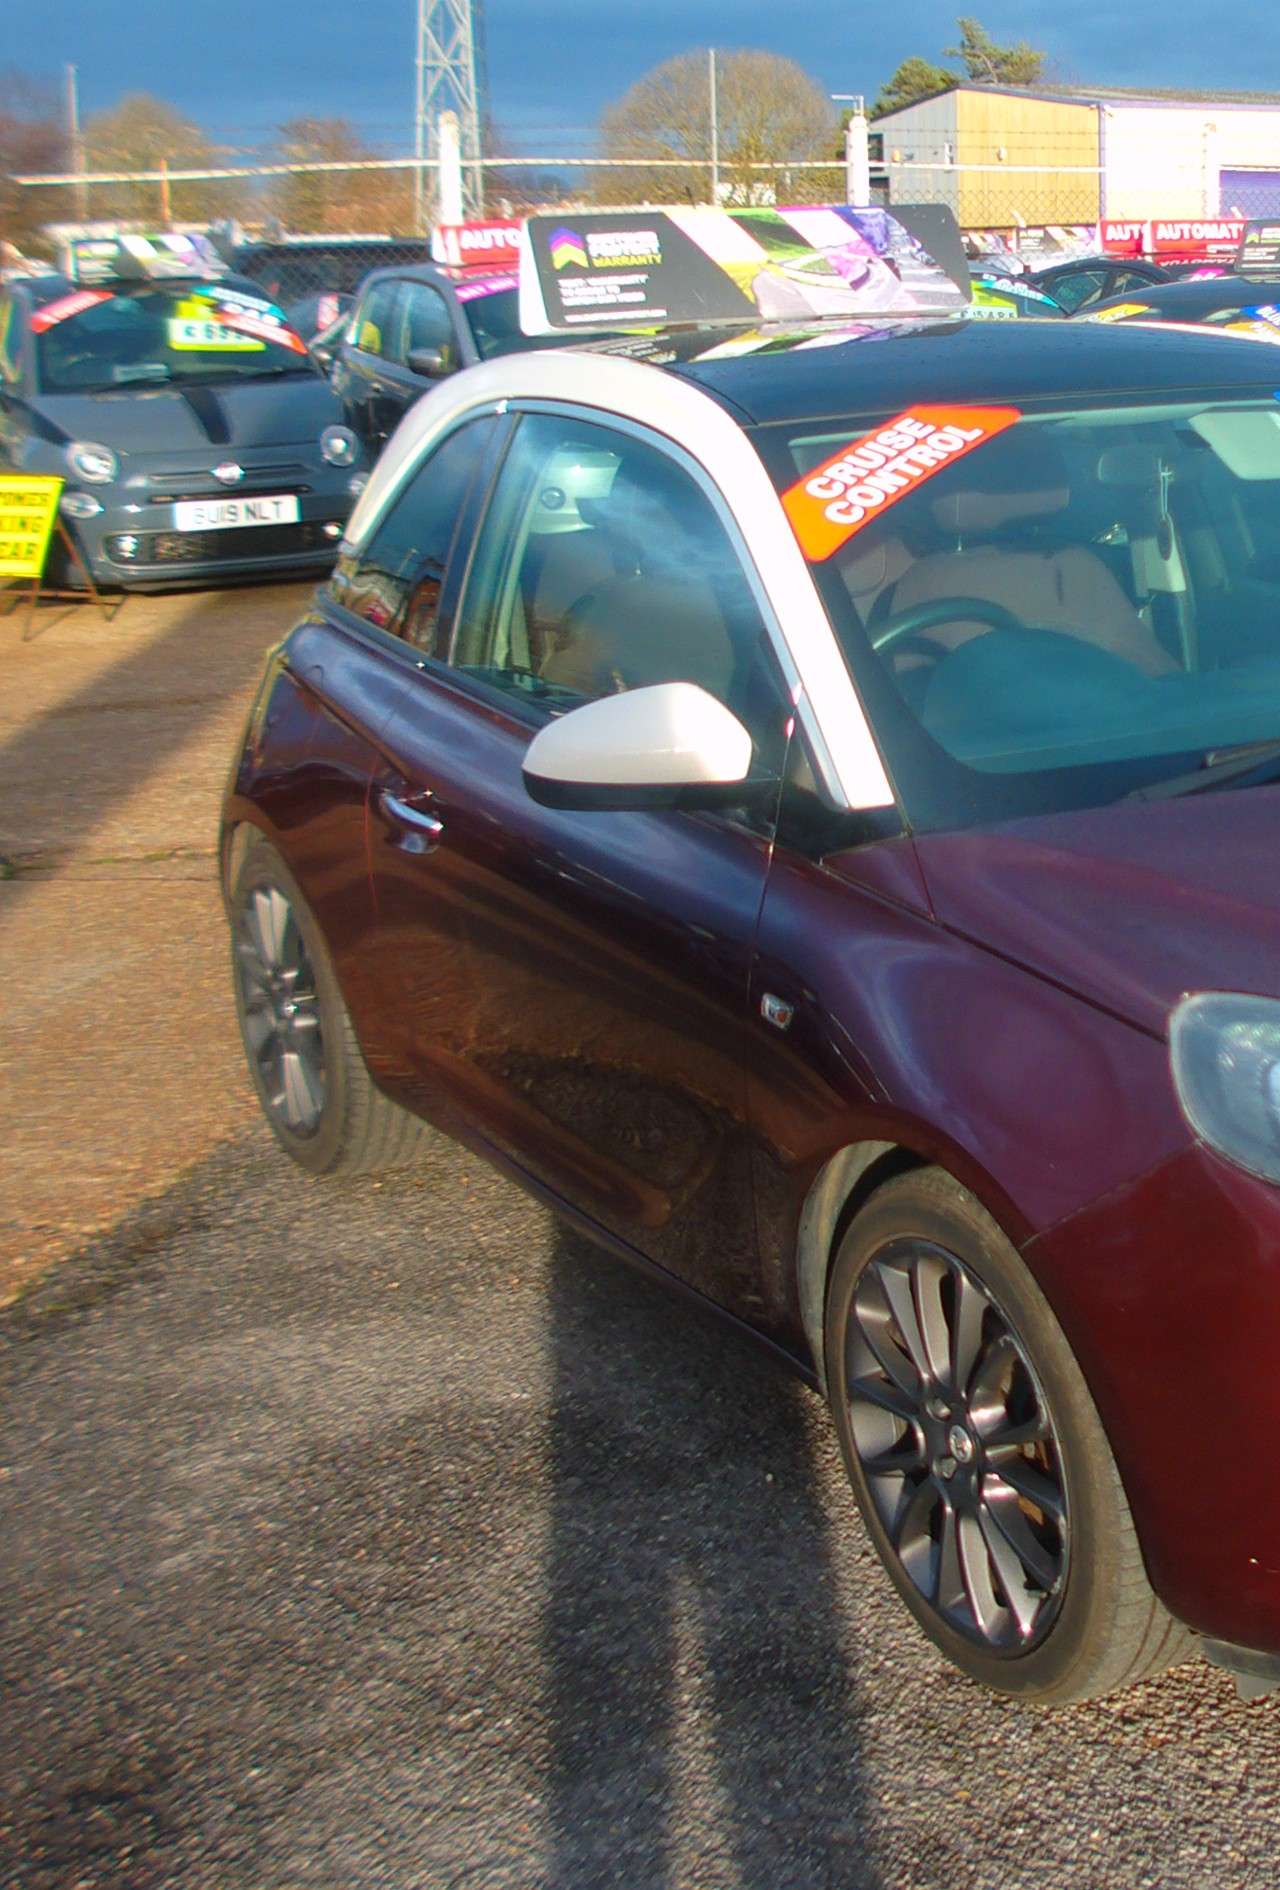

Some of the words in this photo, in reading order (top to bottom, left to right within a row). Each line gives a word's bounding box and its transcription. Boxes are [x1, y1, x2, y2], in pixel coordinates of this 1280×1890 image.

[592, 254, 663, 268] WARRANTY
[805, 417, 936, 499] CRUISE
[824, 425, 984, 525] CONTROL
[244, 500, 283, 520] NLT
